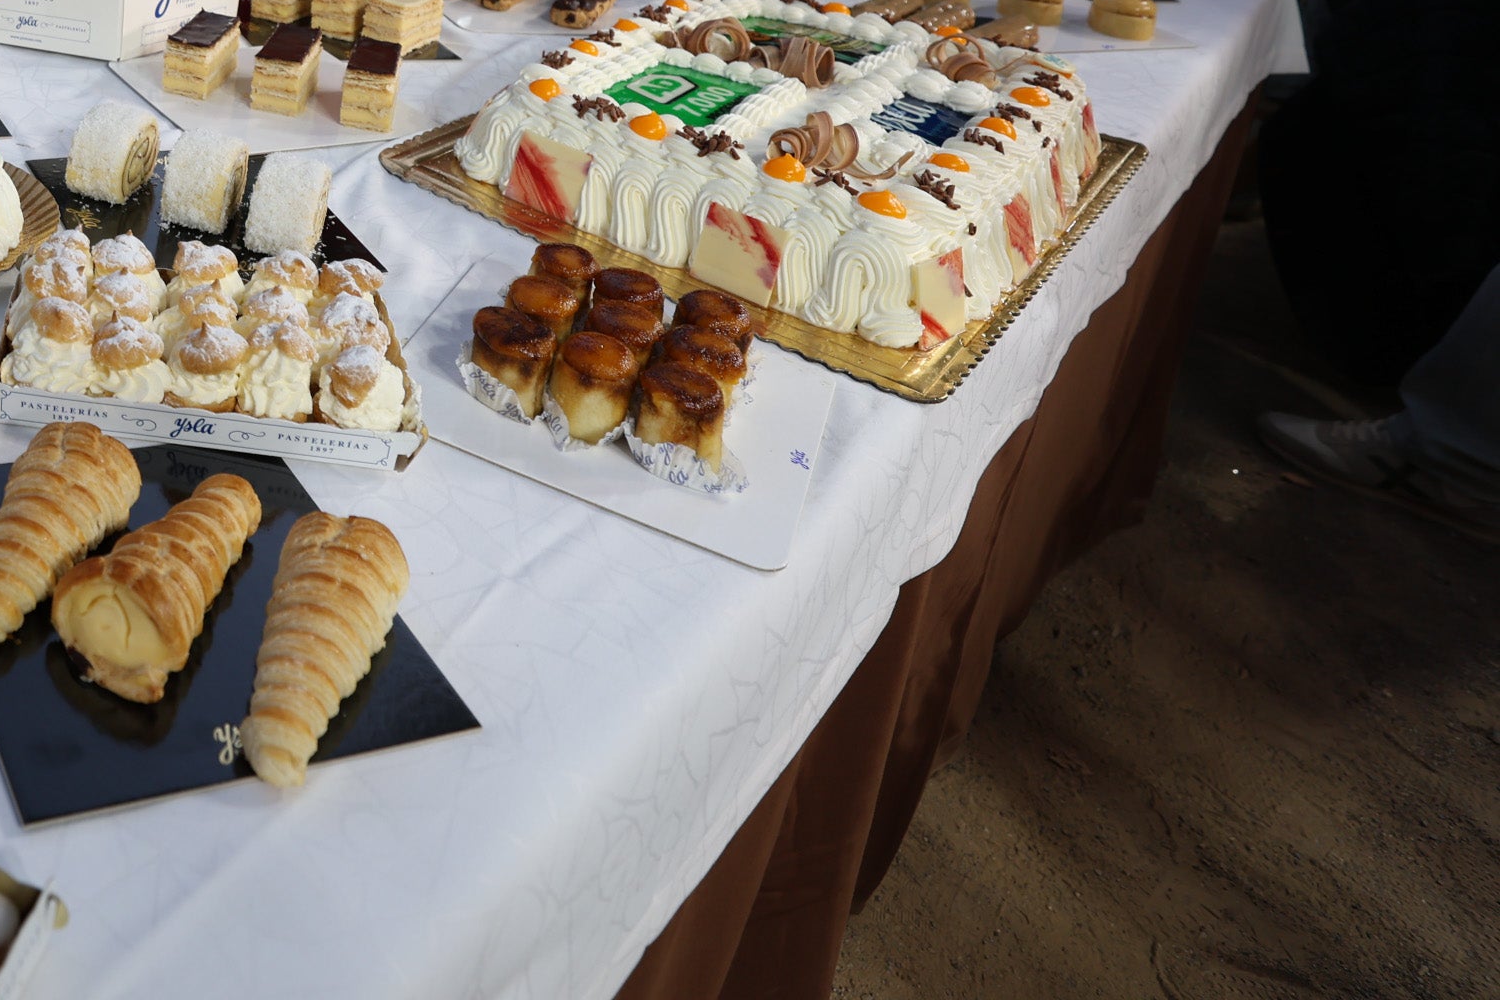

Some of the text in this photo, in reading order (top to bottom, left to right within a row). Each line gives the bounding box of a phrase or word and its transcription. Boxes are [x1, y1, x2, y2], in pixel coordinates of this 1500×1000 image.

[638, 77, 683, 97] AD
[672, 85, 736, 118] 7.000
[20, 401, 109, 418] PASTELERÍAS
[277, 433, 369, 451] PASTELERÍAS
[309, 445, 334, 454] 1897
